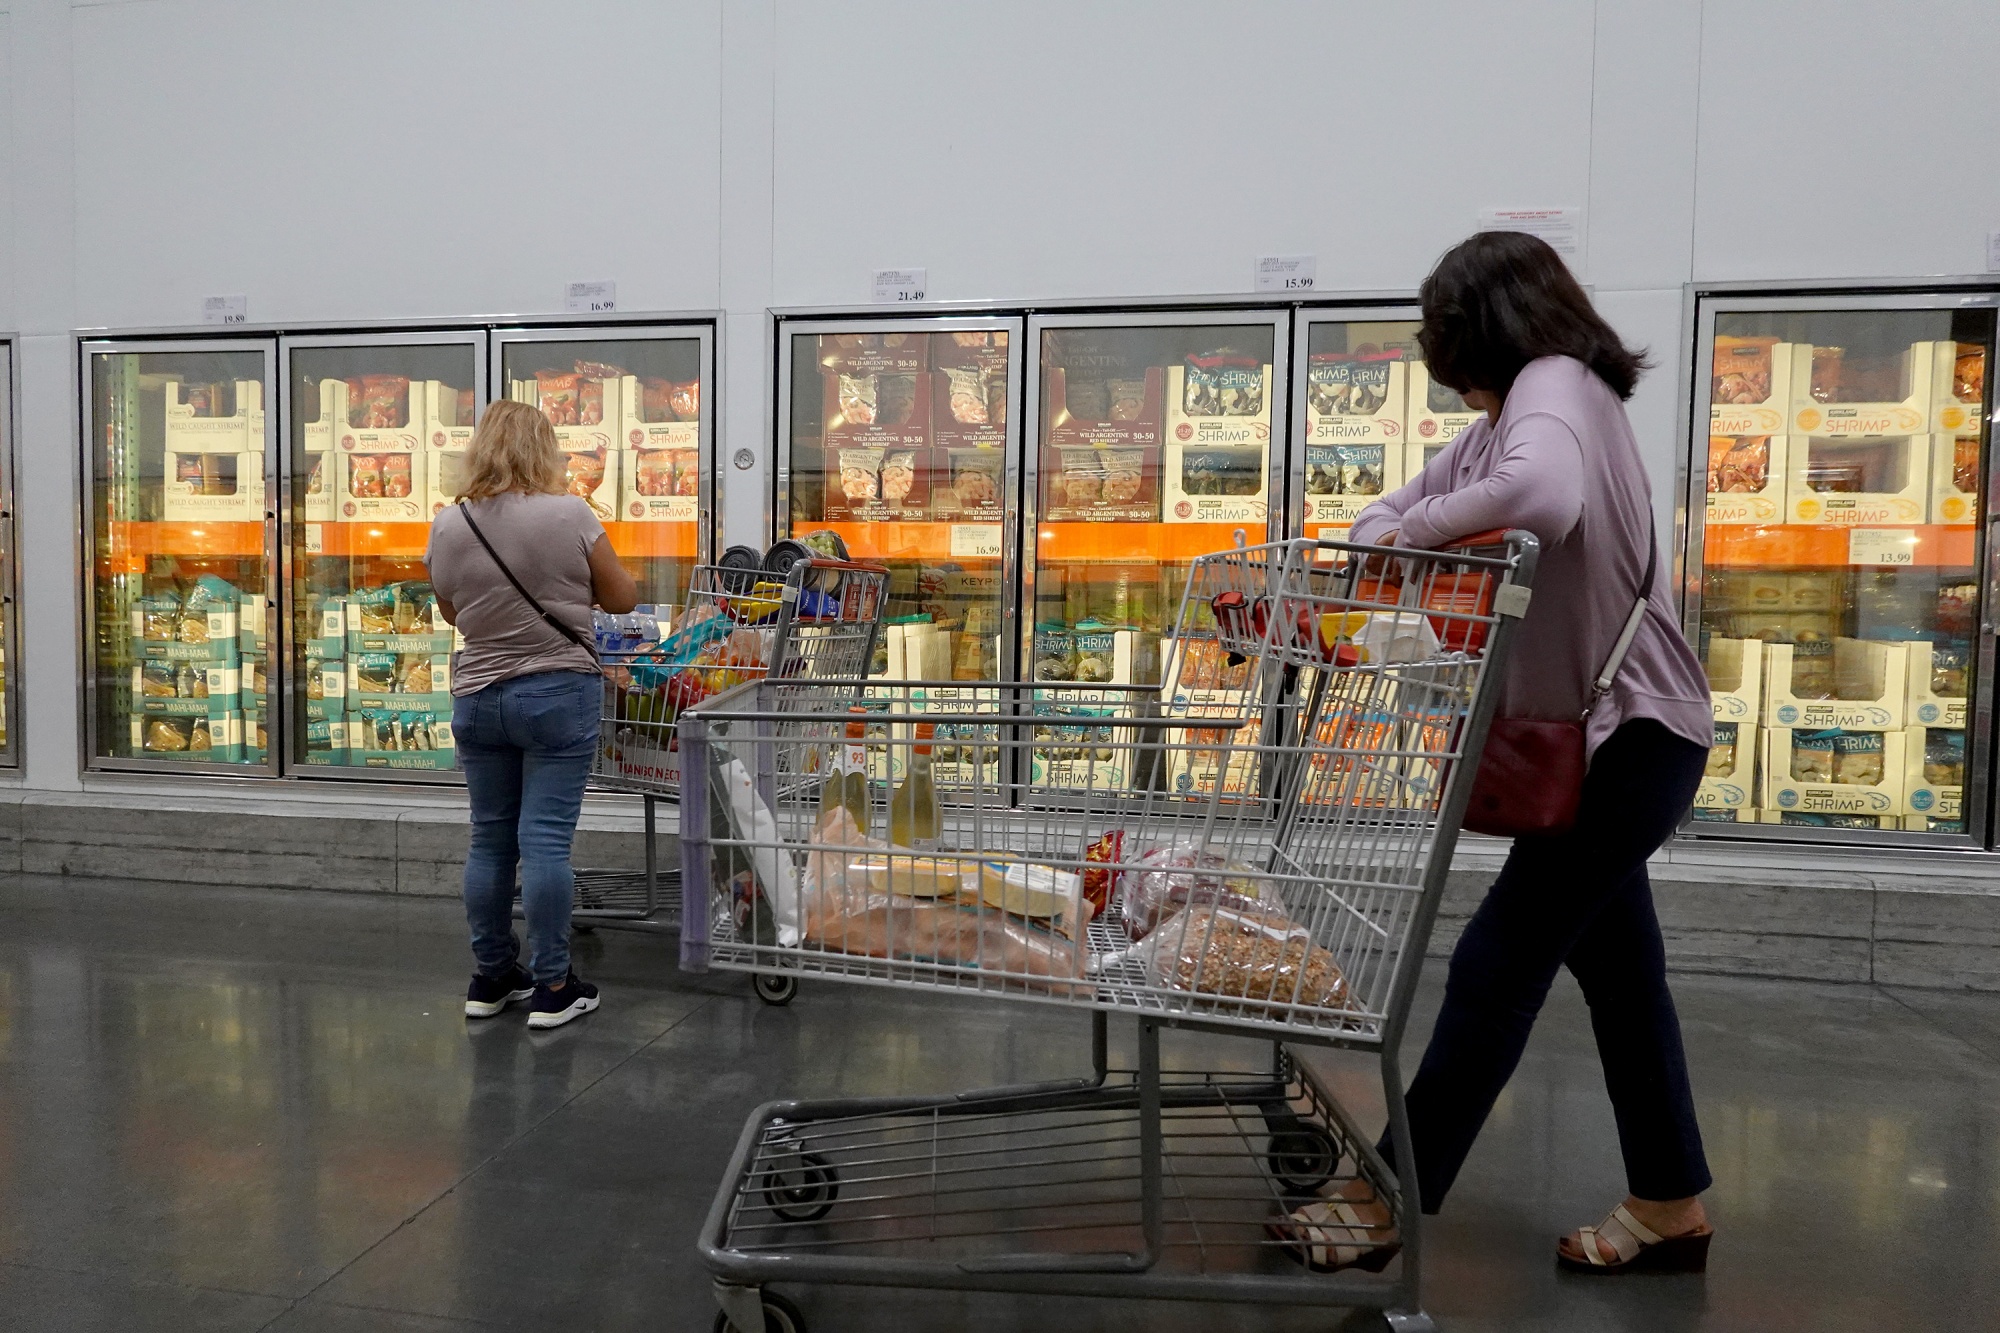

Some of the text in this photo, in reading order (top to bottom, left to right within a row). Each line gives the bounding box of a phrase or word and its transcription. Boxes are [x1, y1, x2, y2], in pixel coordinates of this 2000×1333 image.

[1285, 278, 1313, 288] 15.99
[898, 292, 924, 300] 21.49
[590, 301, 614, 311] 16.99
[1826, 420, 1890, 432] SHRIMP
[1198, 431, 1250, 441] SHRIMP
[1317, 426, 1370, 437] SHRIMP
[650, 434, 691, 444] SHRIMP
[361, 441, 399, 450] SHRIMP
[651, 508, 692, 518] SHRIMP
[1198, 509, 1249, 519] SHRIMP
[1824, 510, 1889, 522] SHRIMP
[976, 546, 999, 554] 16.99
[1880, 553, 1911, 563] 13.99
[387, 641, 431, 651] MAHI-MAHI
[167, 649, 210, 657] MAHI-MAHI
[166, 704, 208, 713] MAHI-MAHI
[385, 702, 430, 711] MAHI-MAHI
[1804, 715, 1864, 726] SHRIMP
[852, 752, 864, 764] 93
[390, 759, 435, 768] MAHI-MAHI
[1803, 799, 1864, 811] SHRIMP
